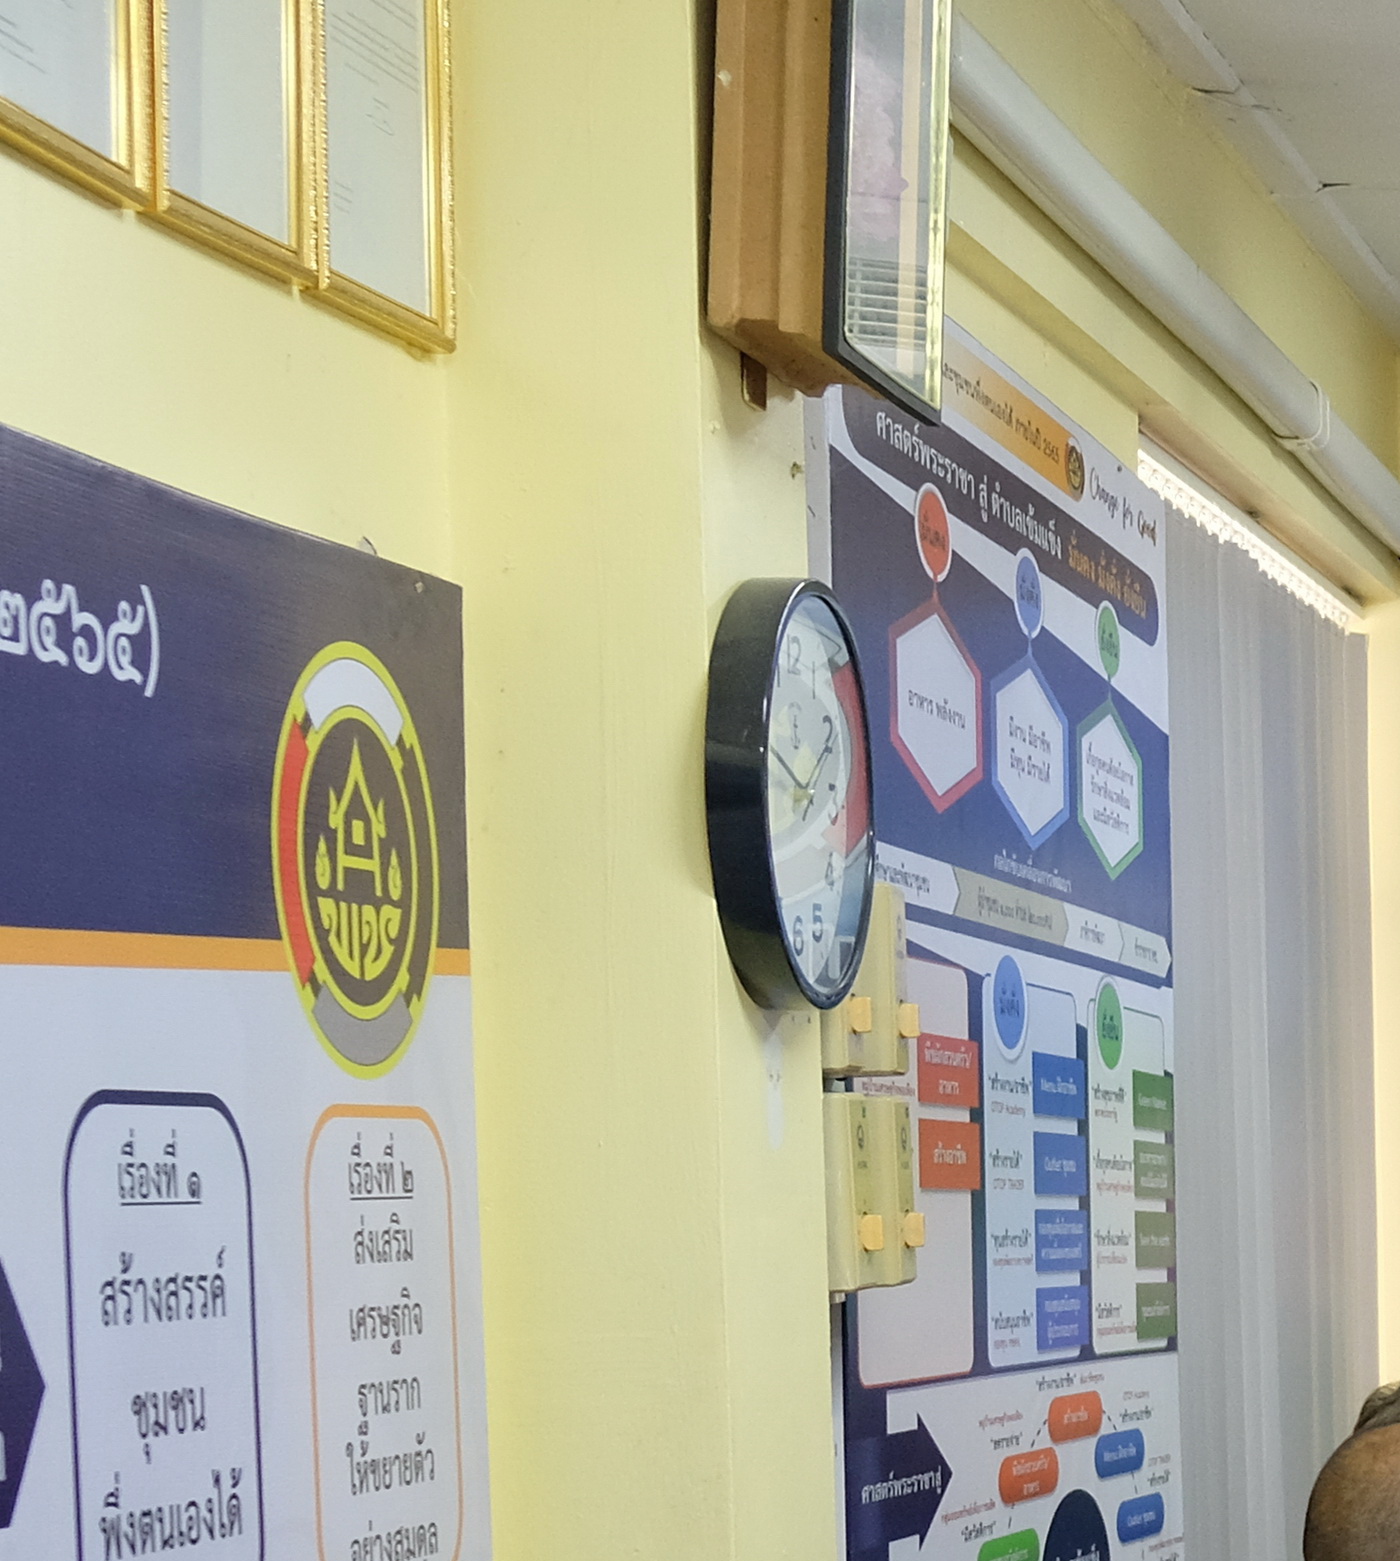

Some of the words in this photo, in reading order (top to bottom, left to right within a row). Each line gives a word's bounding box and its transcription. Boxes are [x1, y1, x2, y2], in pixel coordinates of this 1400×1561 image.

[876, 411, 975, 500] ศาสตร์พระราชา
[979, 475, 988, 523] สู่
[991, 481, 1062, 560] ตำบลเข้มแข็ง
[117, 1128, 179, 1200] เรื่องที่
[186, 1168, 203, 1199] ๑
[347, 1131, 397, 1198] เรื่องที่
[399, 1160, 415, 1195] ๒
[352, 1211, 415, 1266] ส่งเสริม
[100, 1244, 228, 1328] สร้างสรรค์
[348, 1288, 425, 1356] เศรษฐกิจ
[130, 1384, 207, 1465] ชุมชน
[356, 1374, 423, 1436] ฐานราก
[345, 1430, 437, 1498] ให้ขยายตัว
